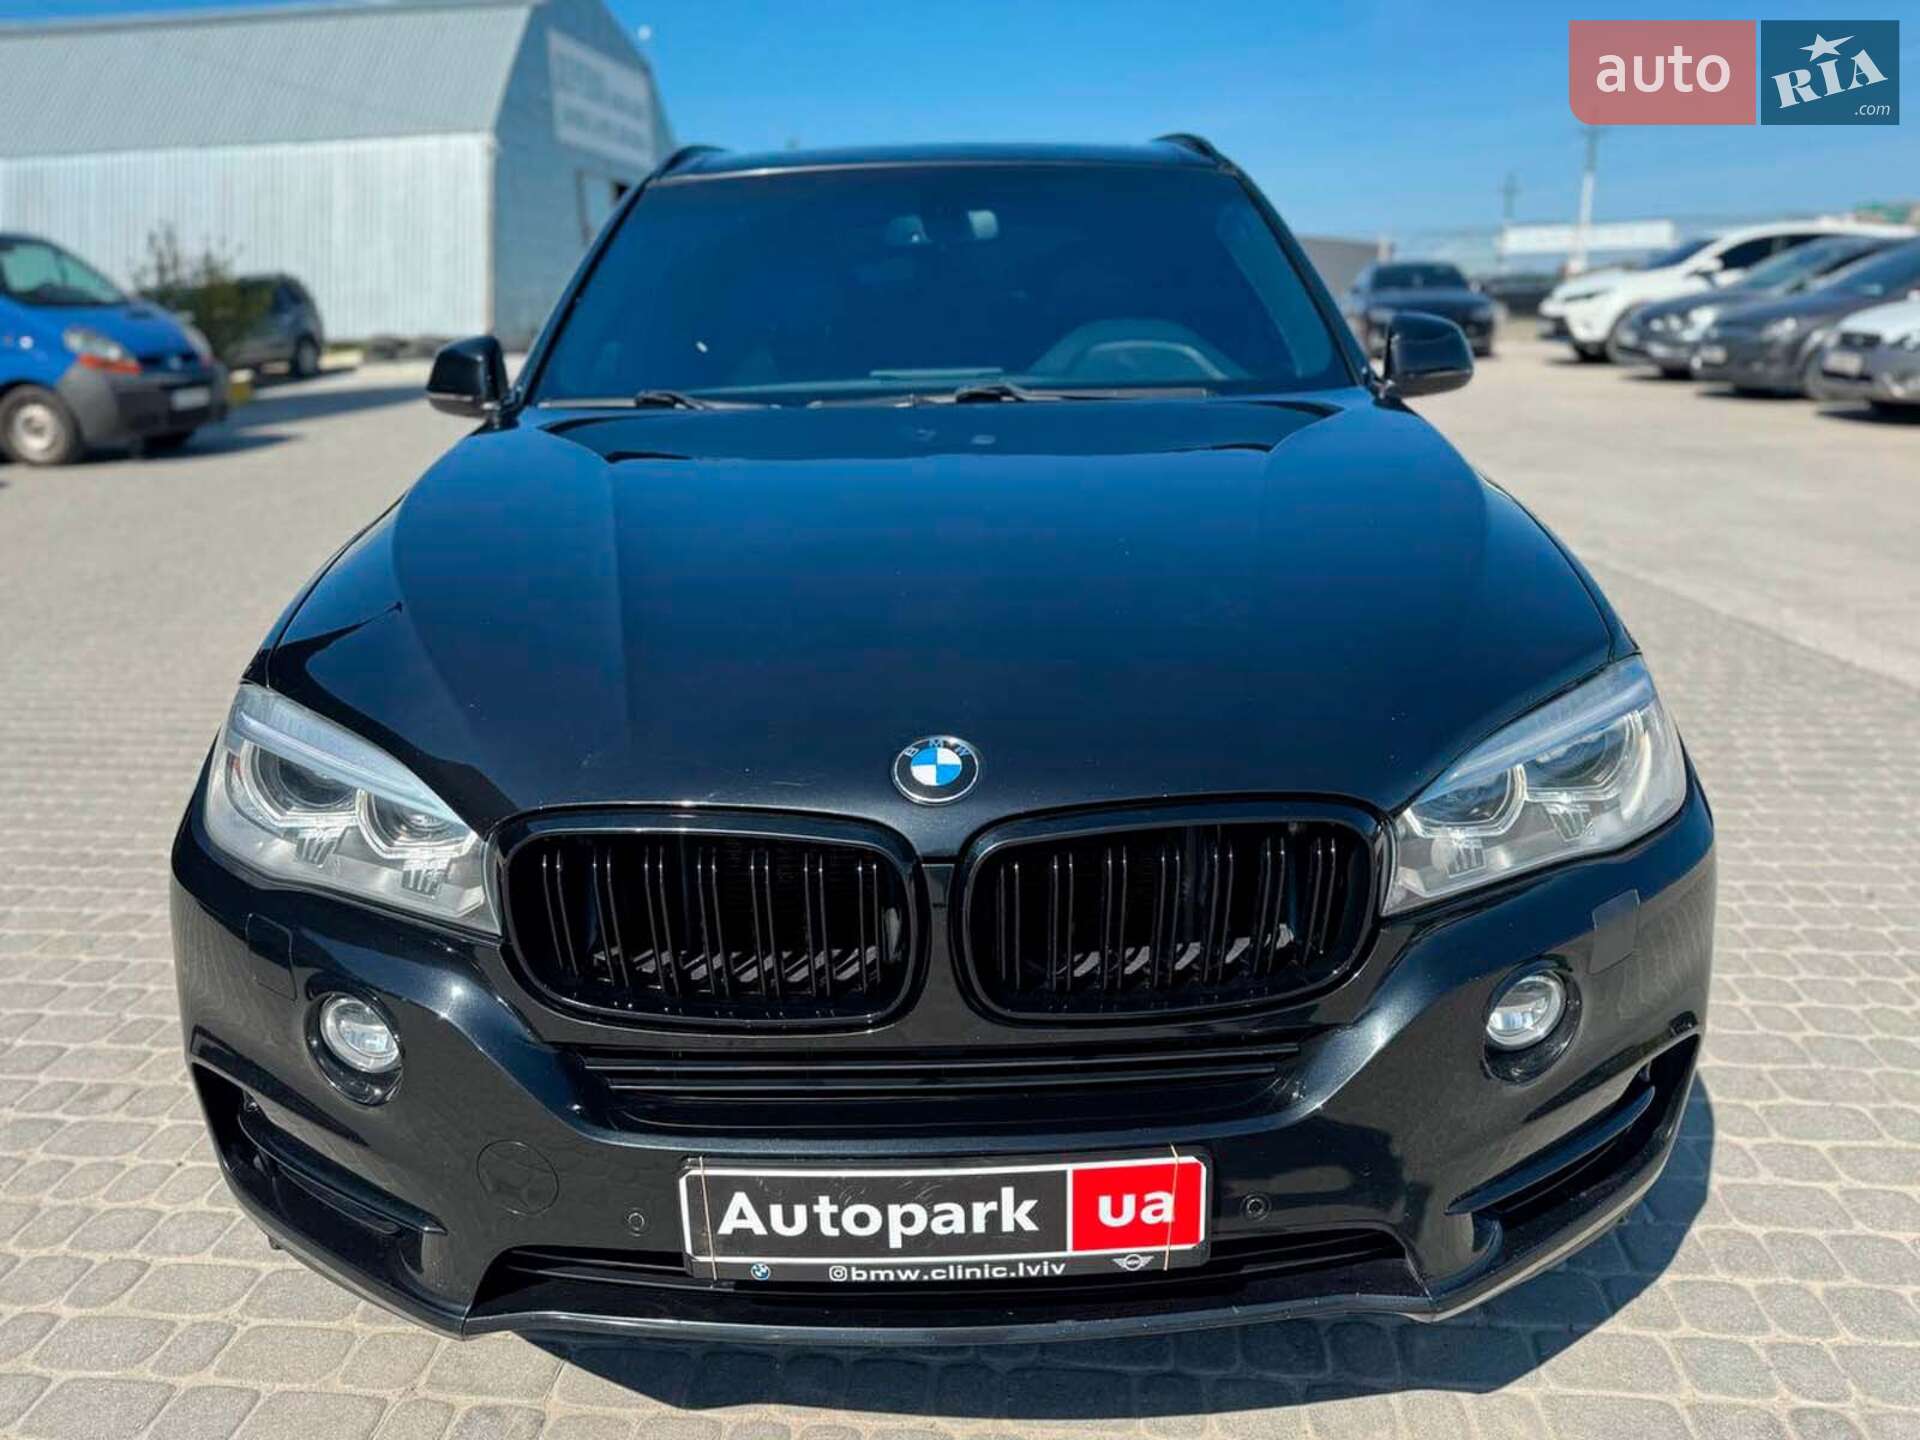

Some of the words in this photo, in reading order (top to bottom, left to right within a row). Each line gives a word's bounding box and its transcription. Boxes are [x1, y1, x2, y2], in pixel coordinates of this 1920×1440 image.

[904, 738, 970, 758] BMW
[717, 1186, 1039, 1249] Autopark
[1098, 1190, 1175, 1228] ua
[851, 1261, 1066, 1281] bmw.clinic.lviv
